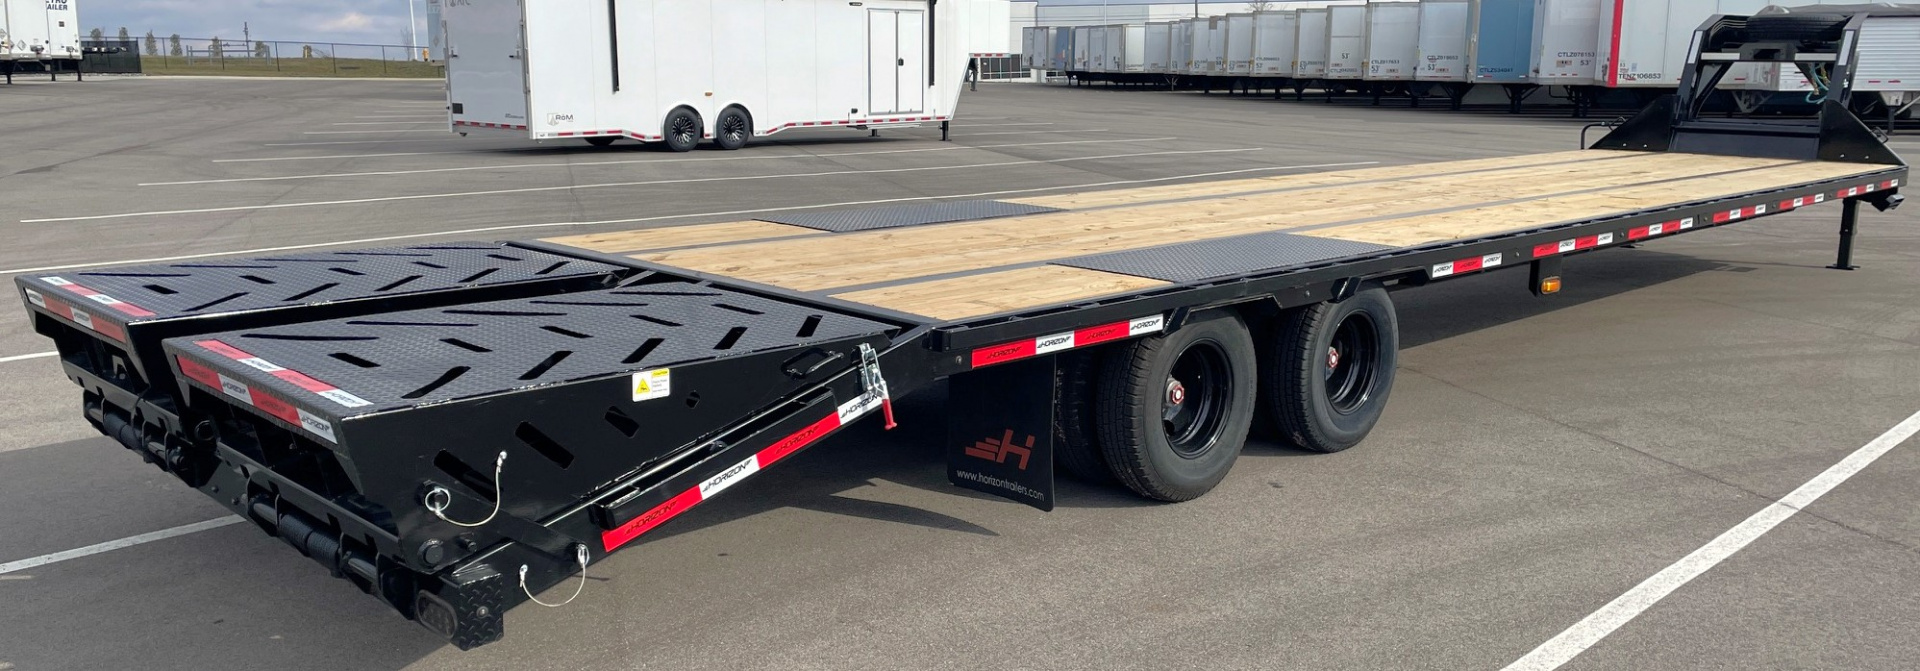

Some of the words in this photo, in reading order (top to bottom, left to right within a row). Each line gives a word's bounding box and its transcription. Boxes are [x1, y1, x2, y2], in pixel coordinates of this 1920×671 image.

[1087, 328, 1117, 340] HORIZON
[1131, 318, 1160, 331] HORIZON
[987, 346, 1022, 360] HORIZON
[1037, 336, 1071, 349] HORIZON
[775, 425, 820, 454] HORIZON
[702, 459, 752, 493] HORIZON
[956, 470, 1045, 501] www.horizontrailers.com
[625, 500, 677, 535] HORIZON
